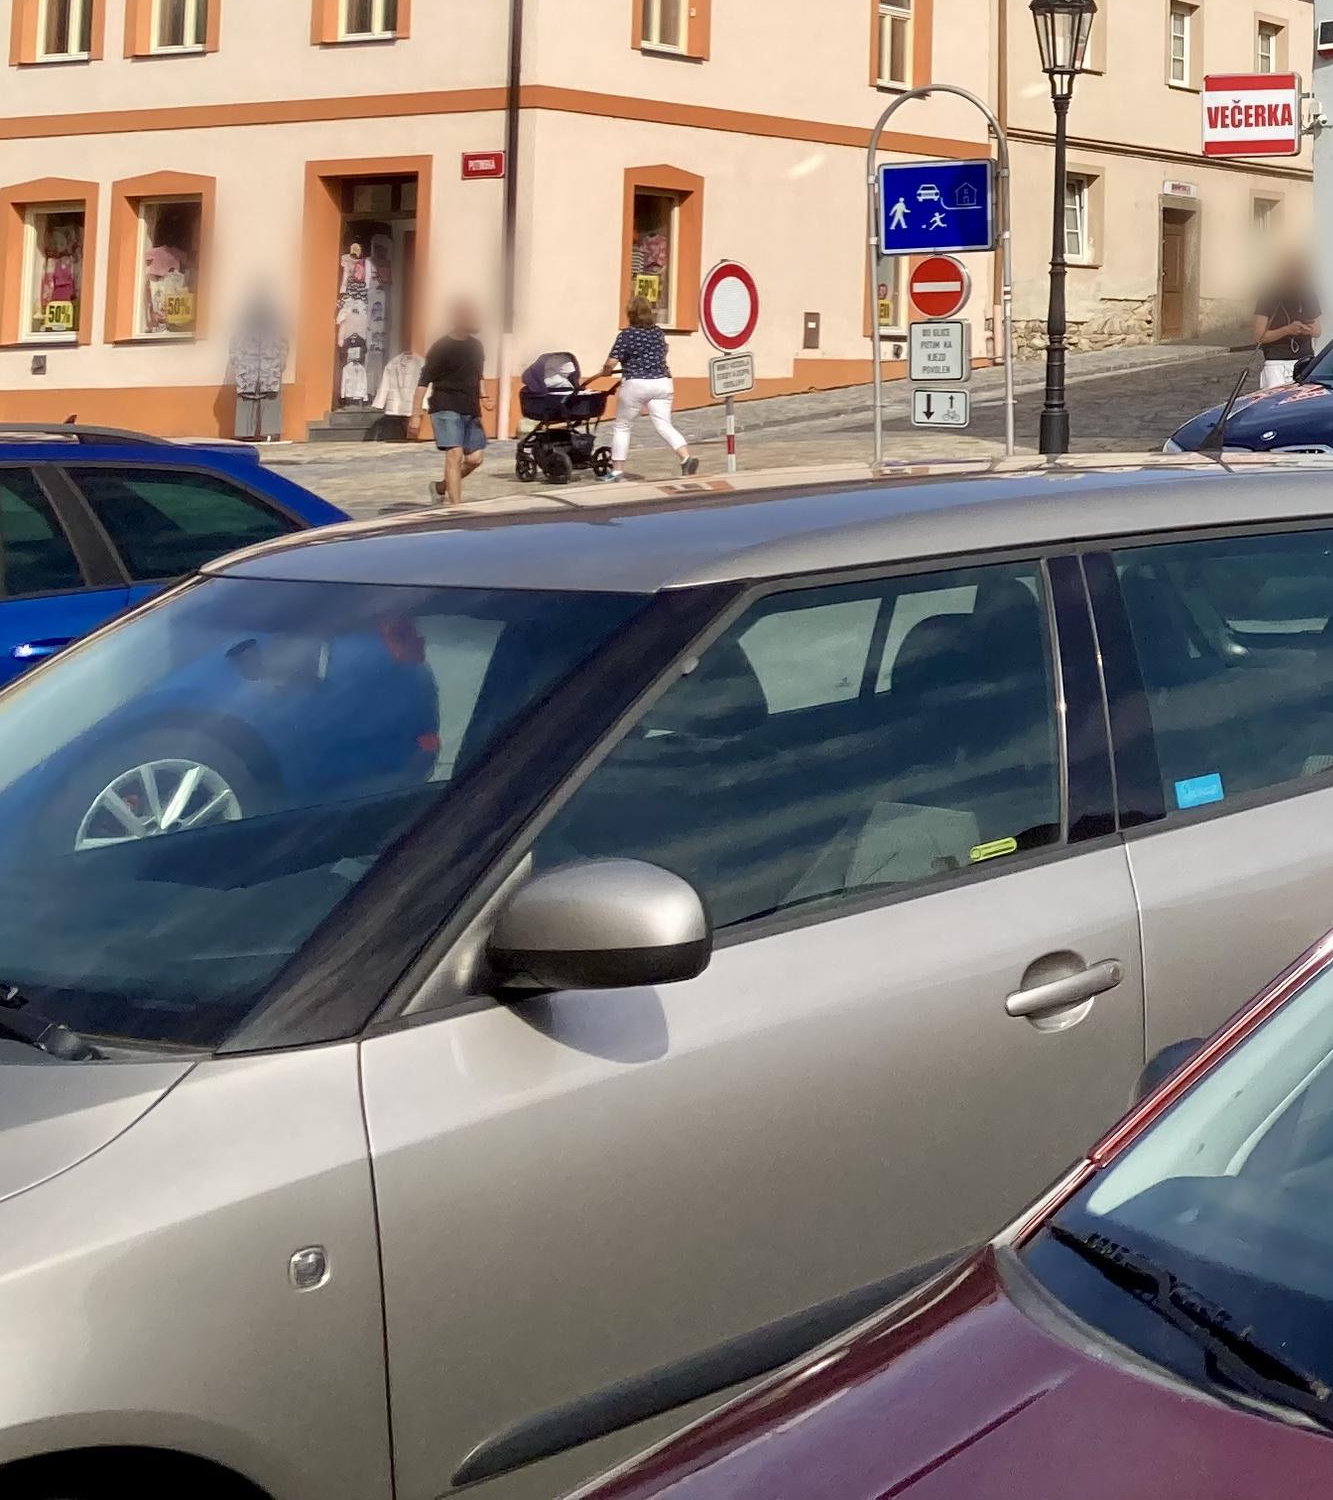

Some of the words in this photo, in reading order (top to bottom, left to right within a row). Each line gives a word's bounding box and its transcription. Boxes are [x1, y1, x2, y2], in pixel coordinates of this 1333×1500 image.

[1206, 99, 1294, 129] VEČERKA
[48, 305, 70, 323] 50%
[167, 297, 191, 315] 50%
